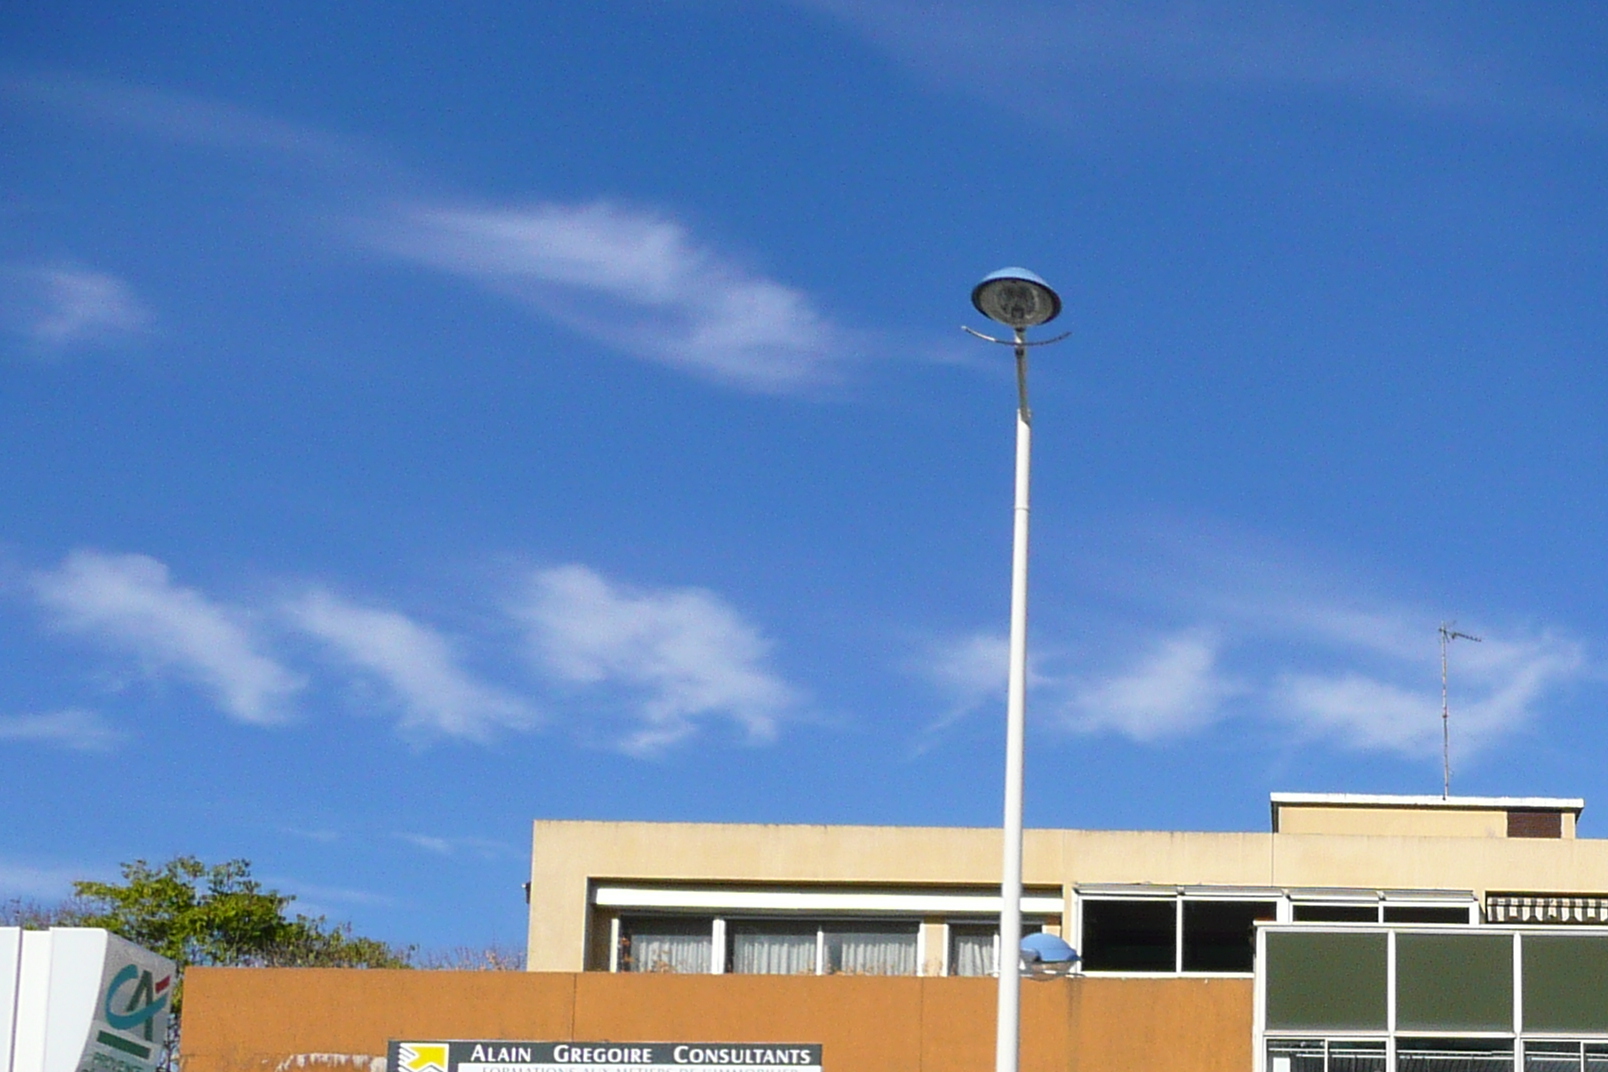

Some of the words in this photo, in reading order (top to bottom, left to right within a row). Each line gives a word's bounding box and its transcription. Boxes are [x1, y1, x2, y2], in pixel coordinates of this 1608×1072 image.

[470, 1044, 531, 1062] ALAIN
[553, 1045, 652, 1063] GREGOIRE
[673, 1046, 811, 1064] CONSULTANTS
